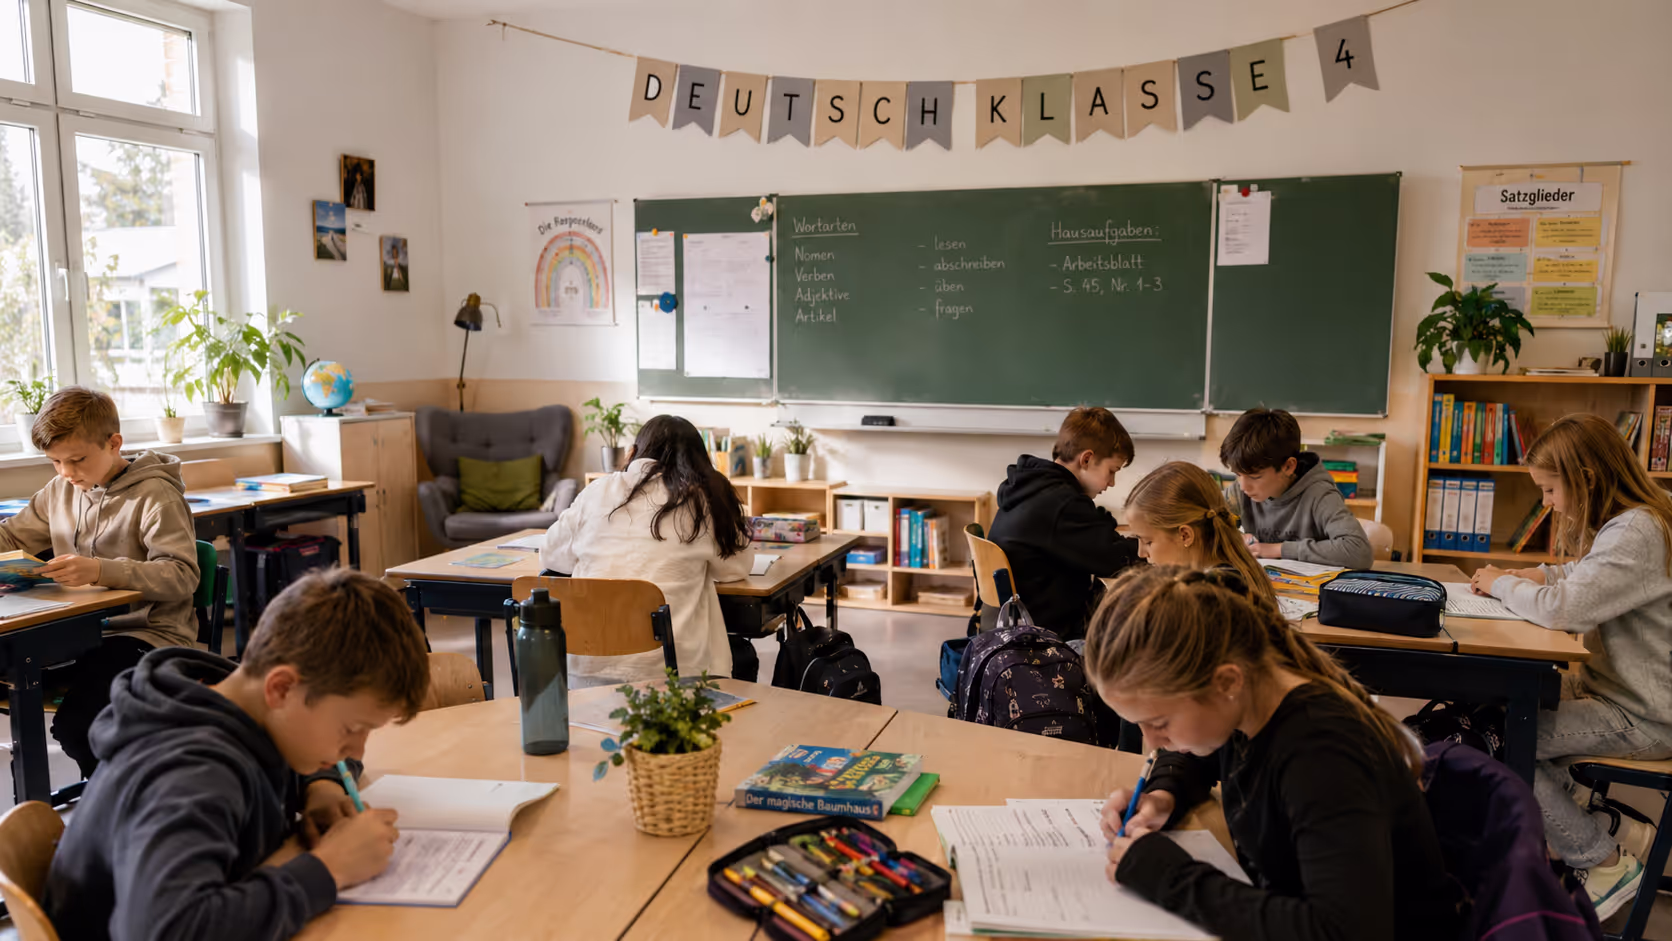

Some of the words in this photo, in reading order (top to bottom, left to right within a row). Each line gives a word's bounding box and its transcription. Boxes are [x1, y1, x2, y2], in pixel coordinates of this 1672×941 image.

[644, 73, 938, 125] DEUTSCH
[990, 60, 1269, 123] KLASSE
[1334, 38, 1355, 70] 4
[1500, 188, 1575, 206] Satzglieder
[793, 217, 856, 233] Wortarten
[1051, 219, 1159, 245] Hausaufgaben:
[934, 235, 966, 250] lesen
[795, 247, 835, 262] Nomen
[1062, 254, 1144, 271] Arbeitsblatt
[934, 256, 1005, 271] abschreiben
[795, 267, 835, 282] Verben
[934, 279, 964, 293] üben
[1082, 278, 1104, 295] 45,
[1111, 277, 1130, 292] Nr.
[1137, 276, 1163, 292] 1-3
[796, 288, 851, 307] Adjektive
[795, 308, 836, 323] Artikel
[935, 299, 974, 319] fragen
[745, 793, 764, 806] Der
[767, 795, 814, 810] magische
[817, 799, 872, 815] Baumhaus
